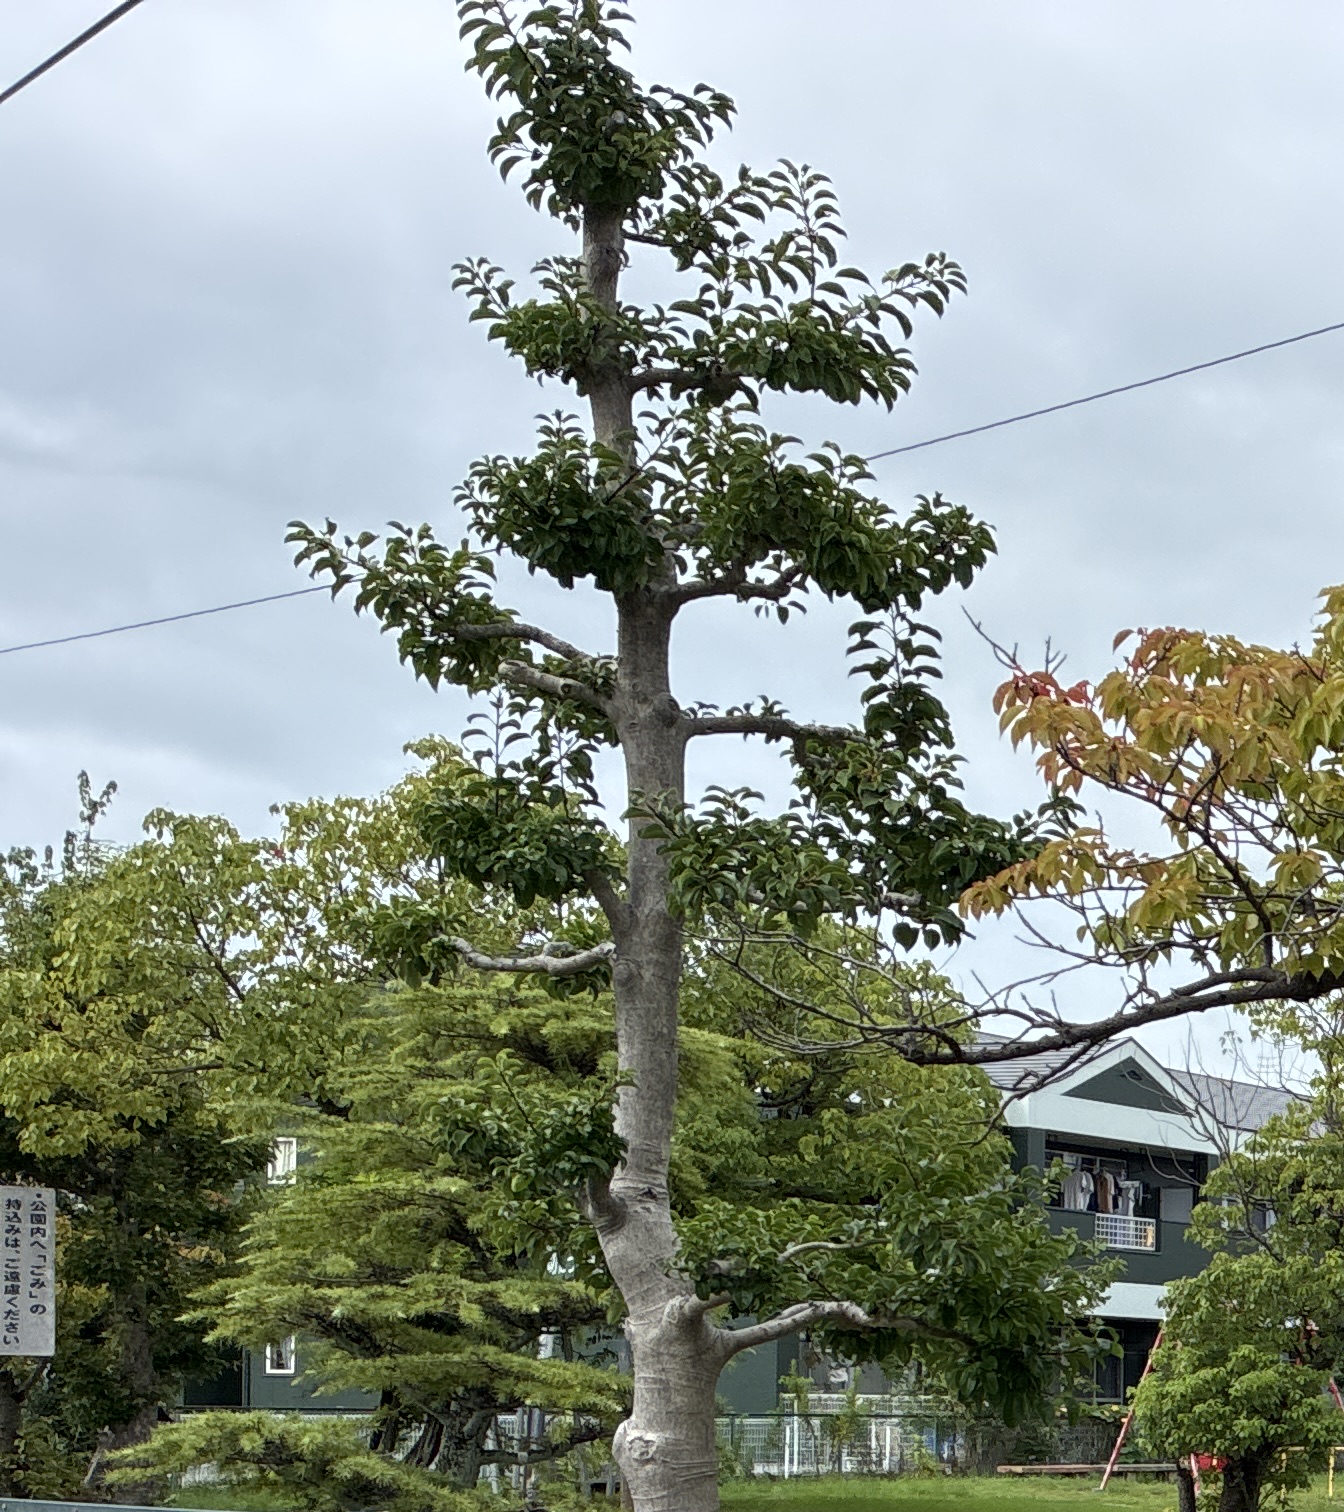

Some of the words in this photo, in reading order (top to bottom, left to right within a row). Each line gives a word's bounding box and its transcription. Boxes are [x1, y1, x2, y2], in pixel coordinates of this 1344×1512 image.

[3, 1198, 21, 1345] 持込みは、ご遠慮ください
